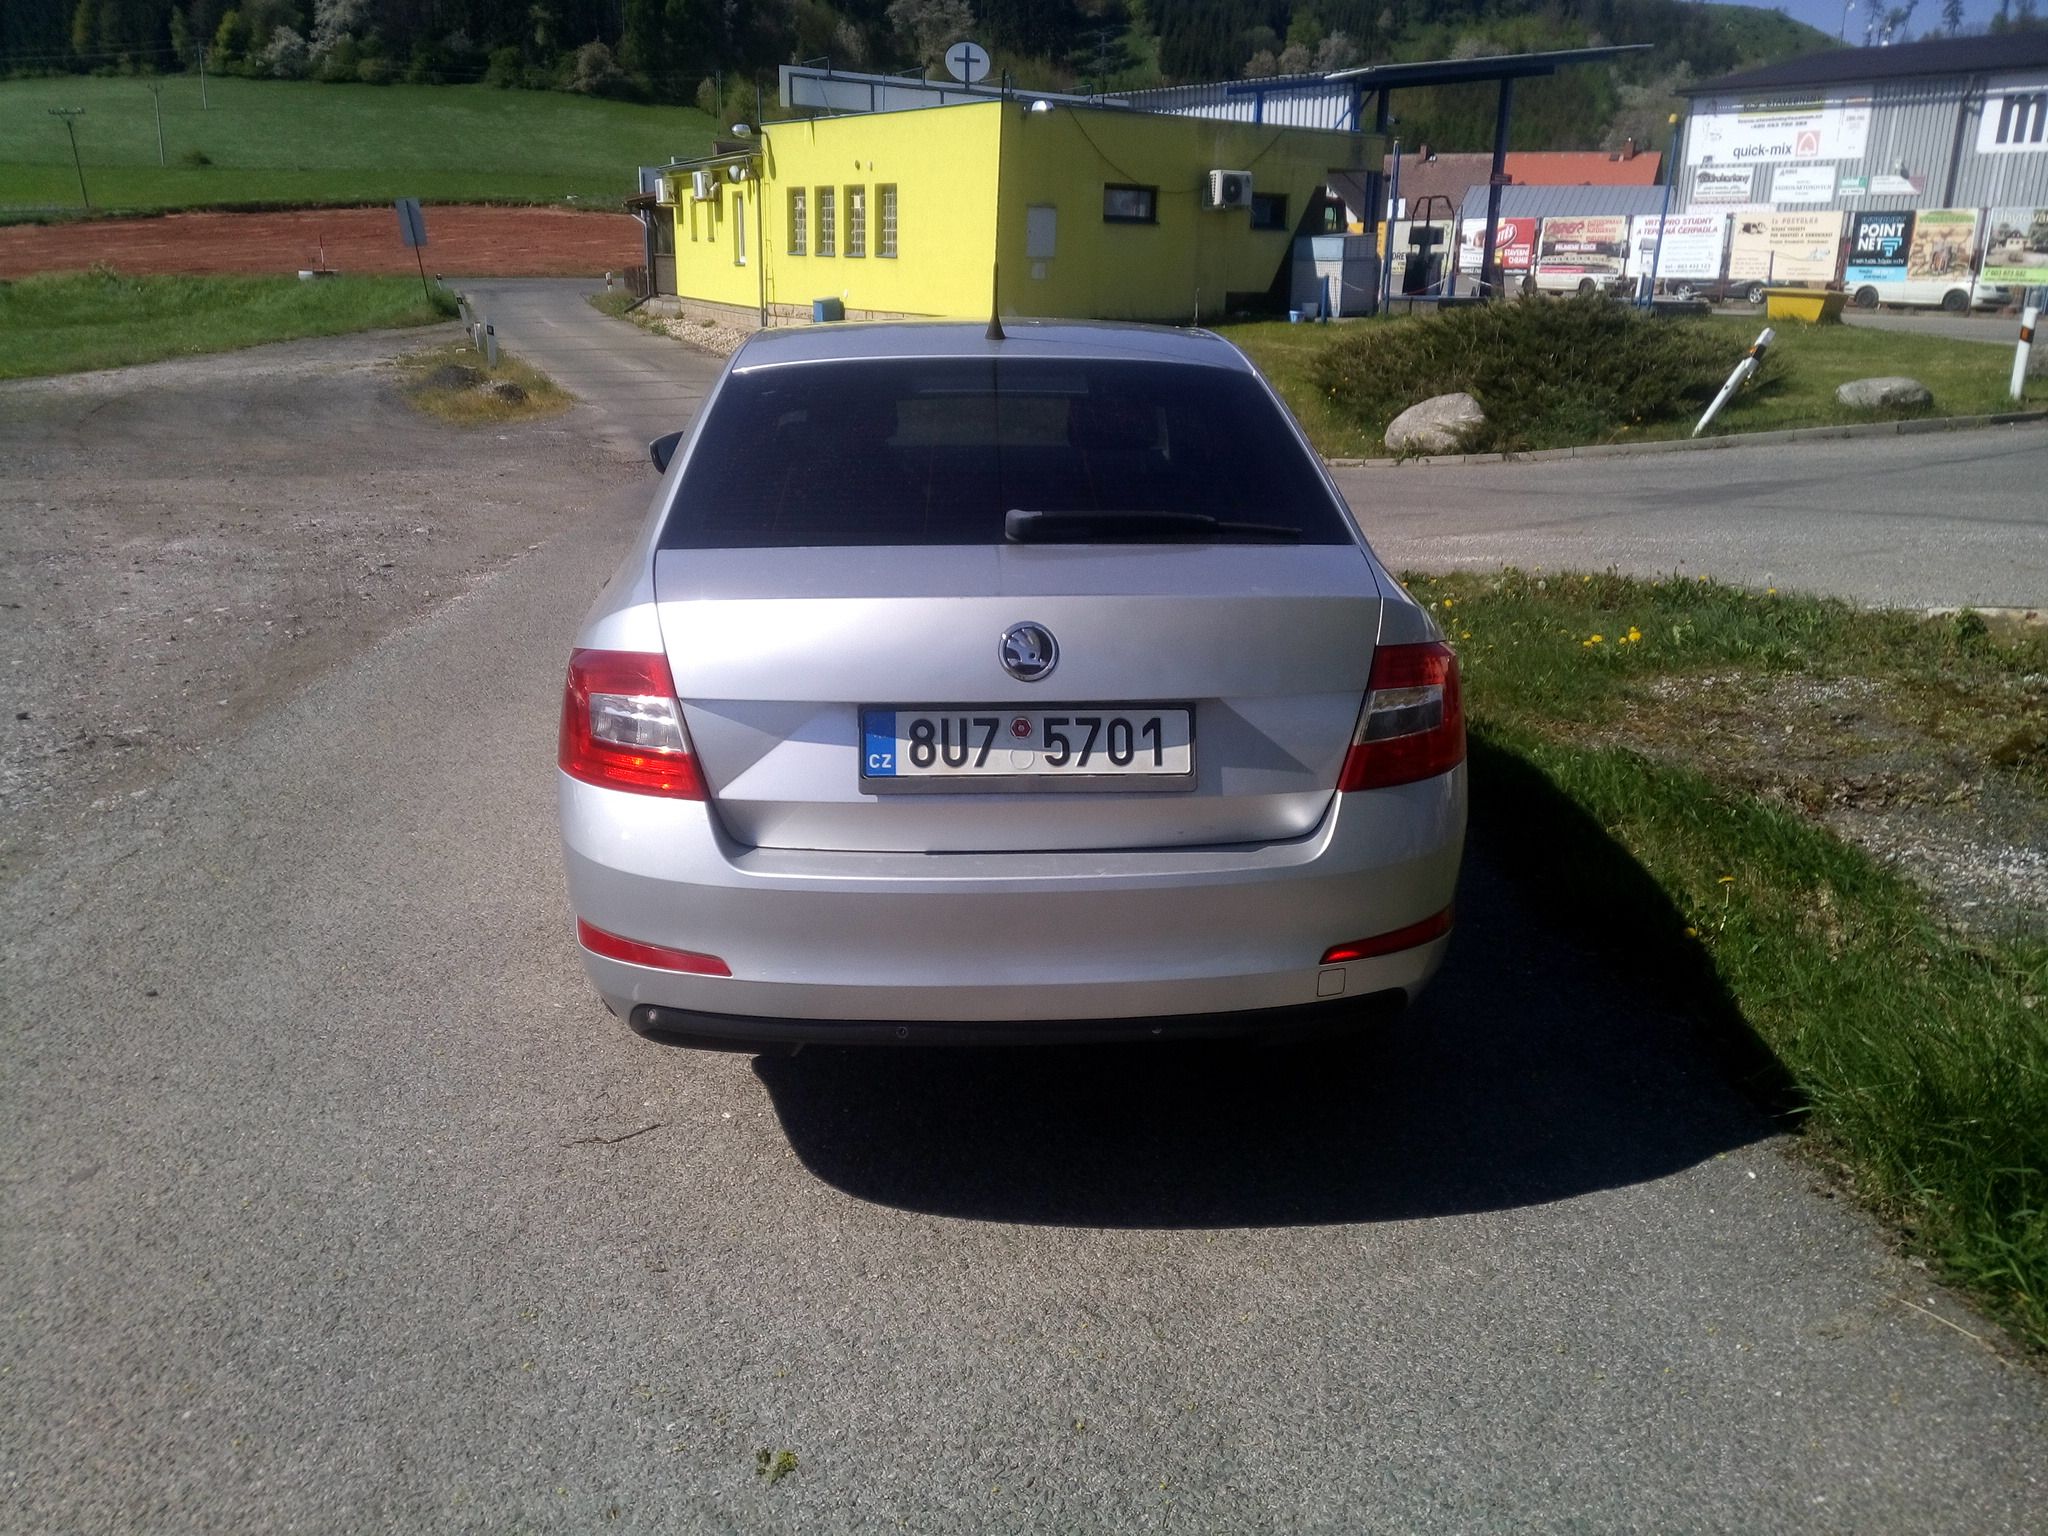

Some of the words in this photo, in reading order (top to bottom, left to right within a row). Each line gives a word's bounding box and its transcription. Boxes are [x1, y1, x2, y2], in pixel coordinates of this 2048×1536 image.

[1733, 142, 1792, 160] quick-mix
[1665, 218, 1681, 226] PRO
[1682, 217, 1713, 225] STUDNY
[1677, 225, 1718, 234] ČERPADLA
[1860, 224, 1904, 237] POINT
[1858, 237, 1882, 250] NET
[908, 718, 1000, 769] 8U7
[1043, 717, 1163, 768] 5701
[869, 754, 892, 769] CZ
